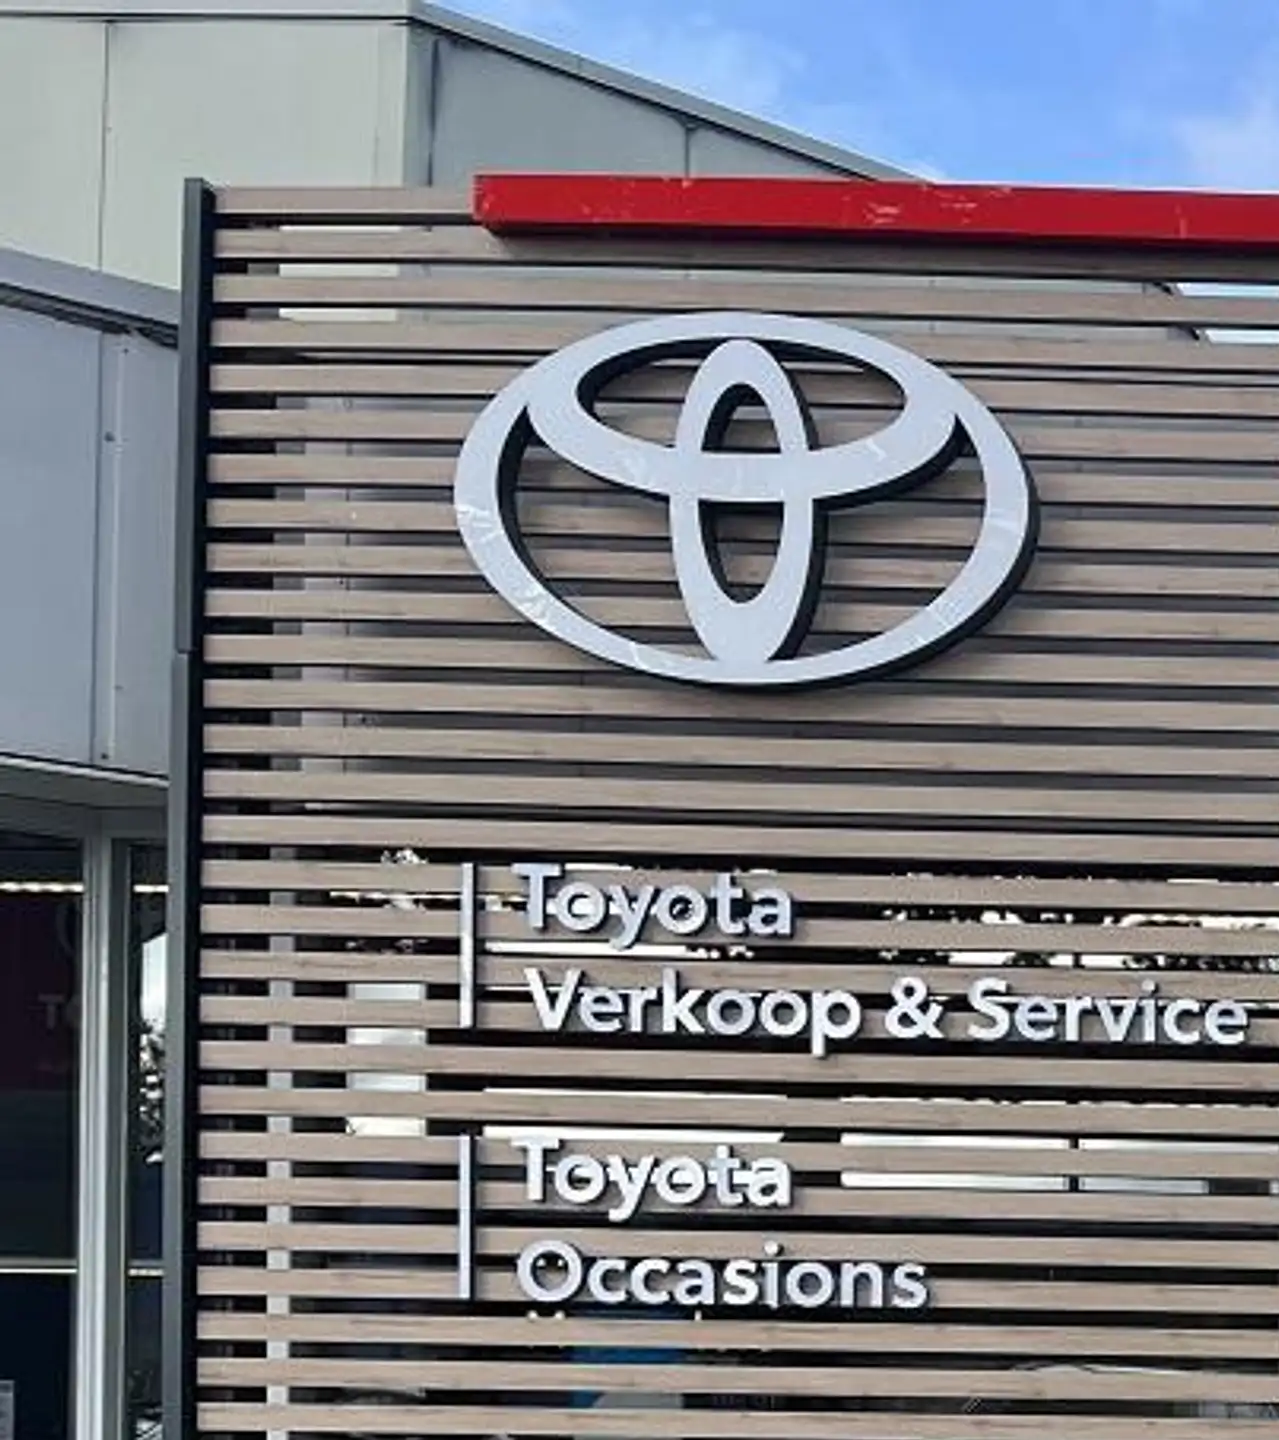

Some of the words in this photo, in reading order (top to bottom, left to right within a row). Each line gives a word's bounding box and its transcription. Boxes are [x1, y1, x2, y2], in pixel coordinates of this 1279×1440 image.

[511, 863, 795, 948] Toyota
[522, 967, 863, 1059] Verkoop
[884, 976, 943, 1040] &
[967, 977, 1251, 1046] Service
[511, 1137, 793, 1223] Toyota
[516, 1239, 931, 1310] Occasions
